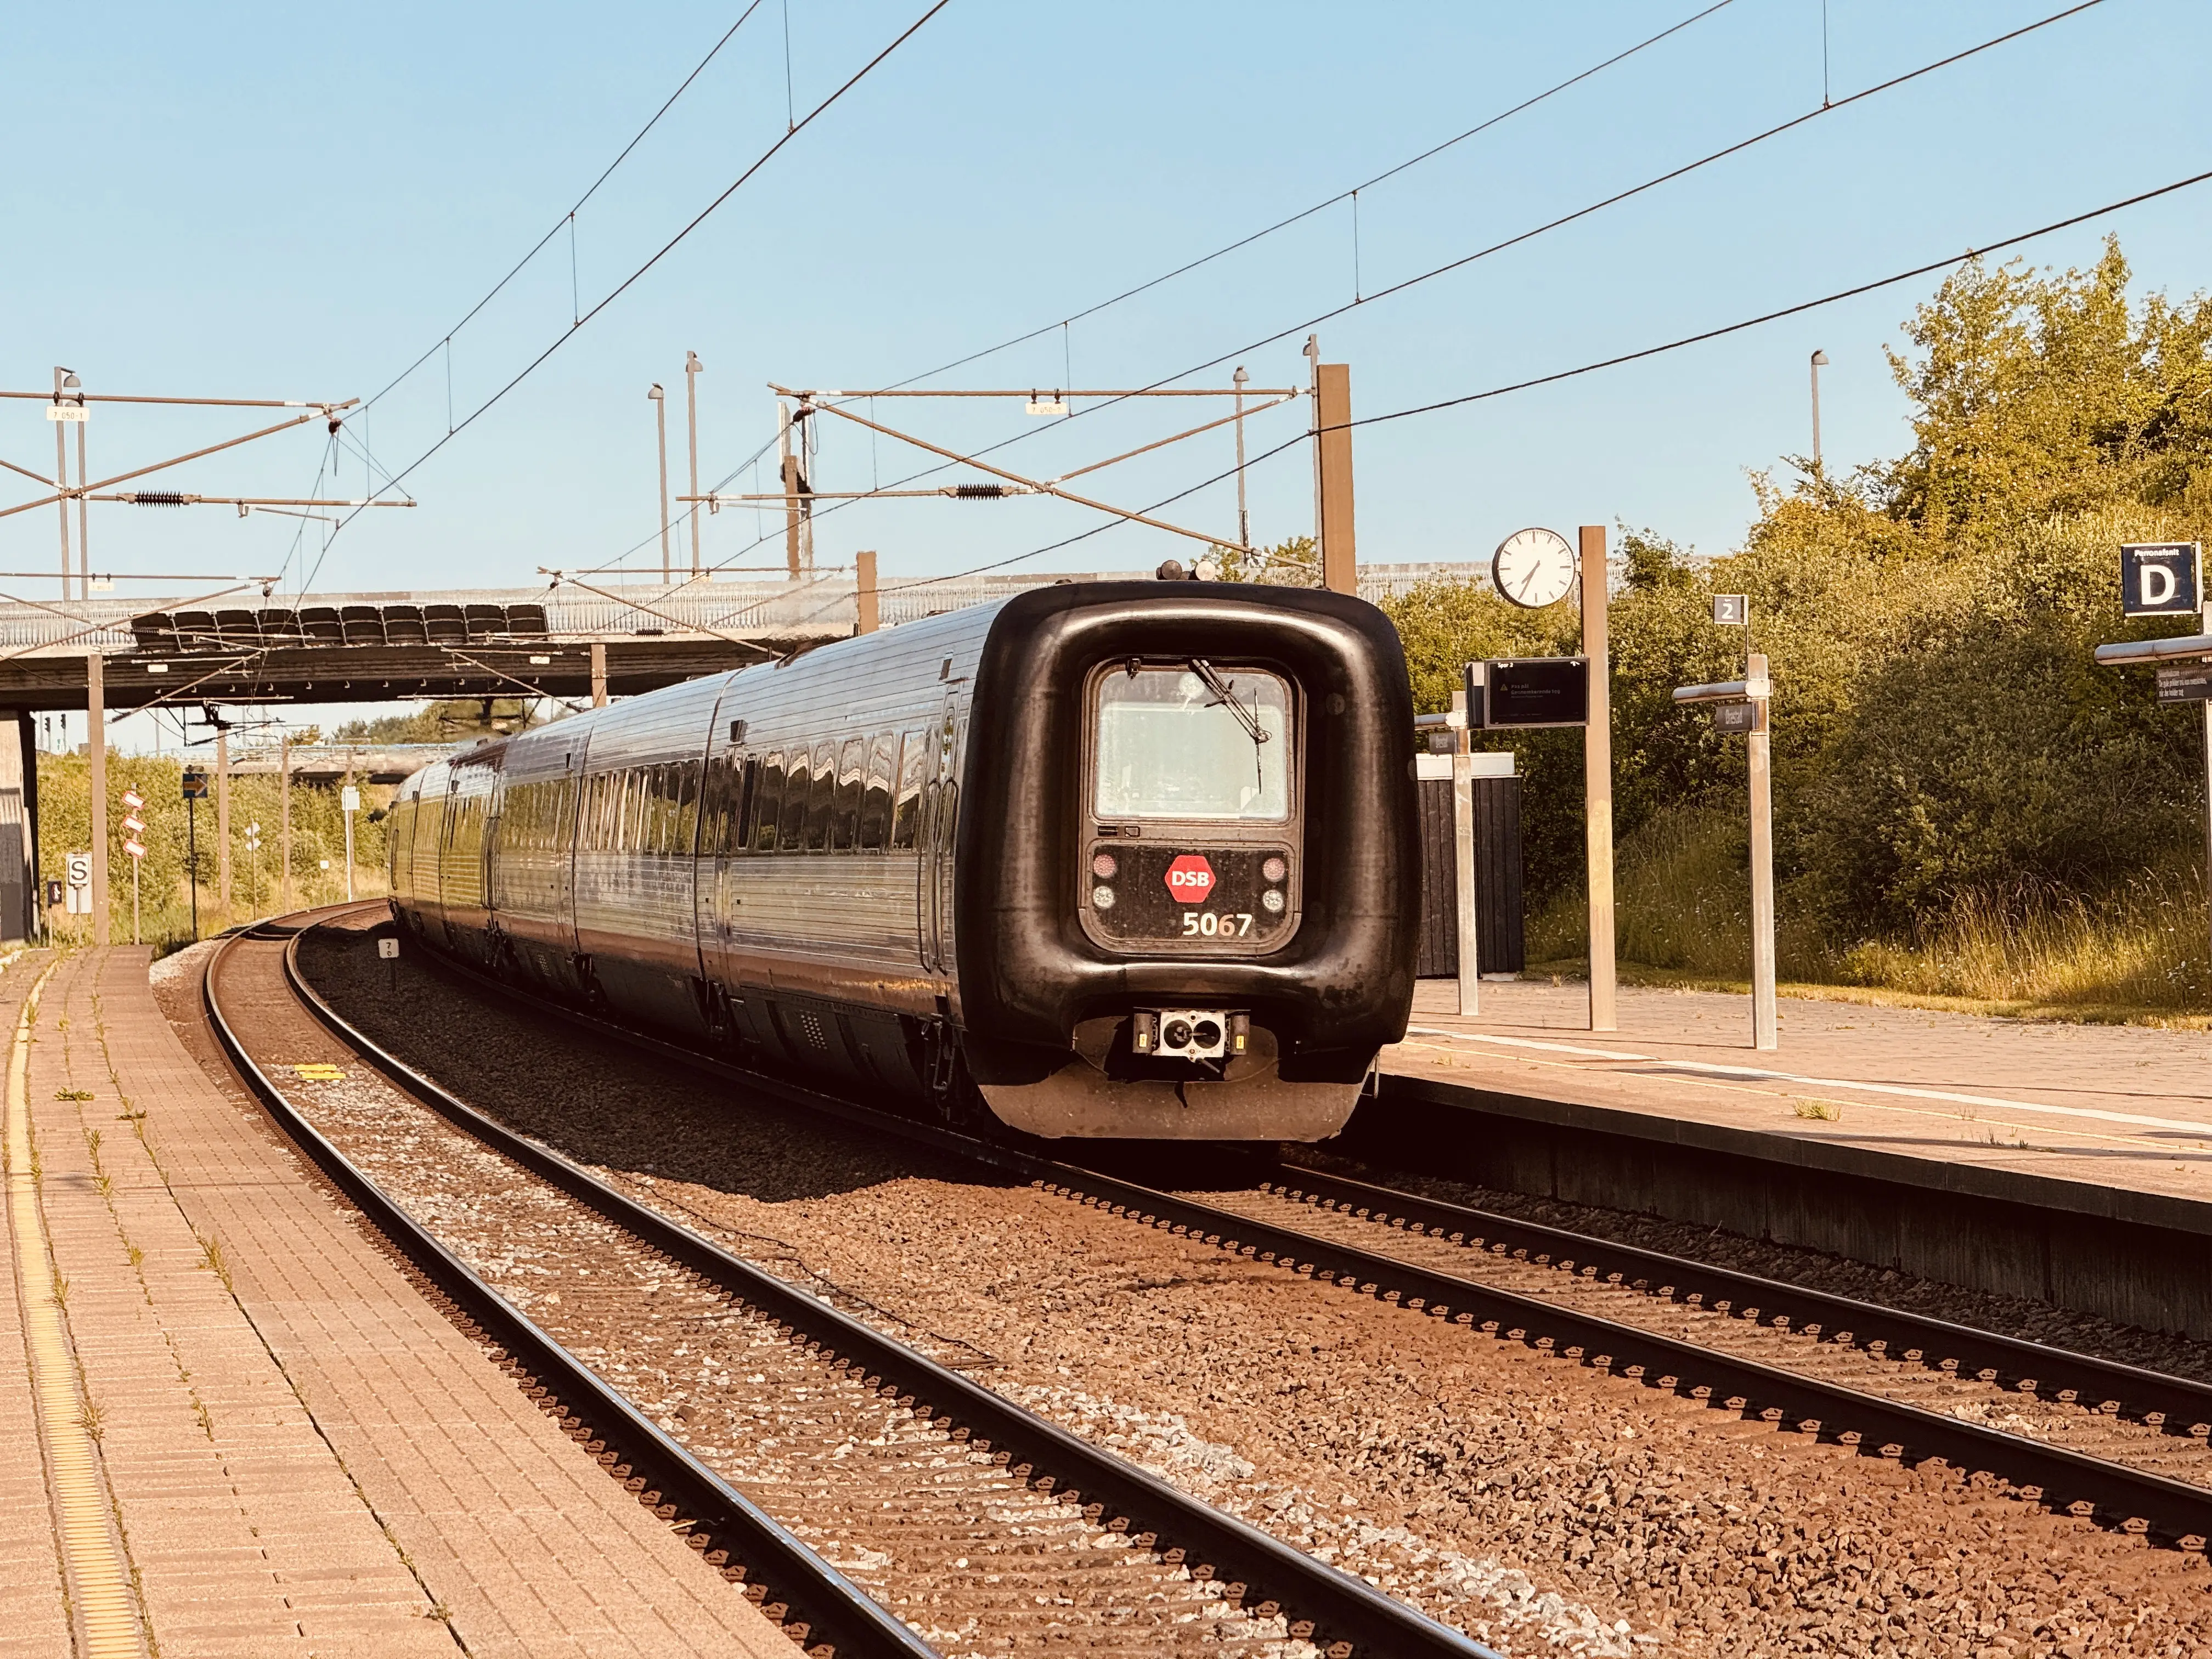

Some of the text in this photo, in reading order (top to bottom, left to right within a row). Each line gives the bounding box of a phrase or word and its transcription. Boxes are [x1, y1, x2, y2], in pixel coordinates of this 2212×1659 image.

[2140, 565, 2175, 605] D
[1722, 603, 1734, 619] 2
[71, 861, 87, 881] S
[1172, 871, 1210, 887] DSB
[1183, 912, 1252, 937] 5067
